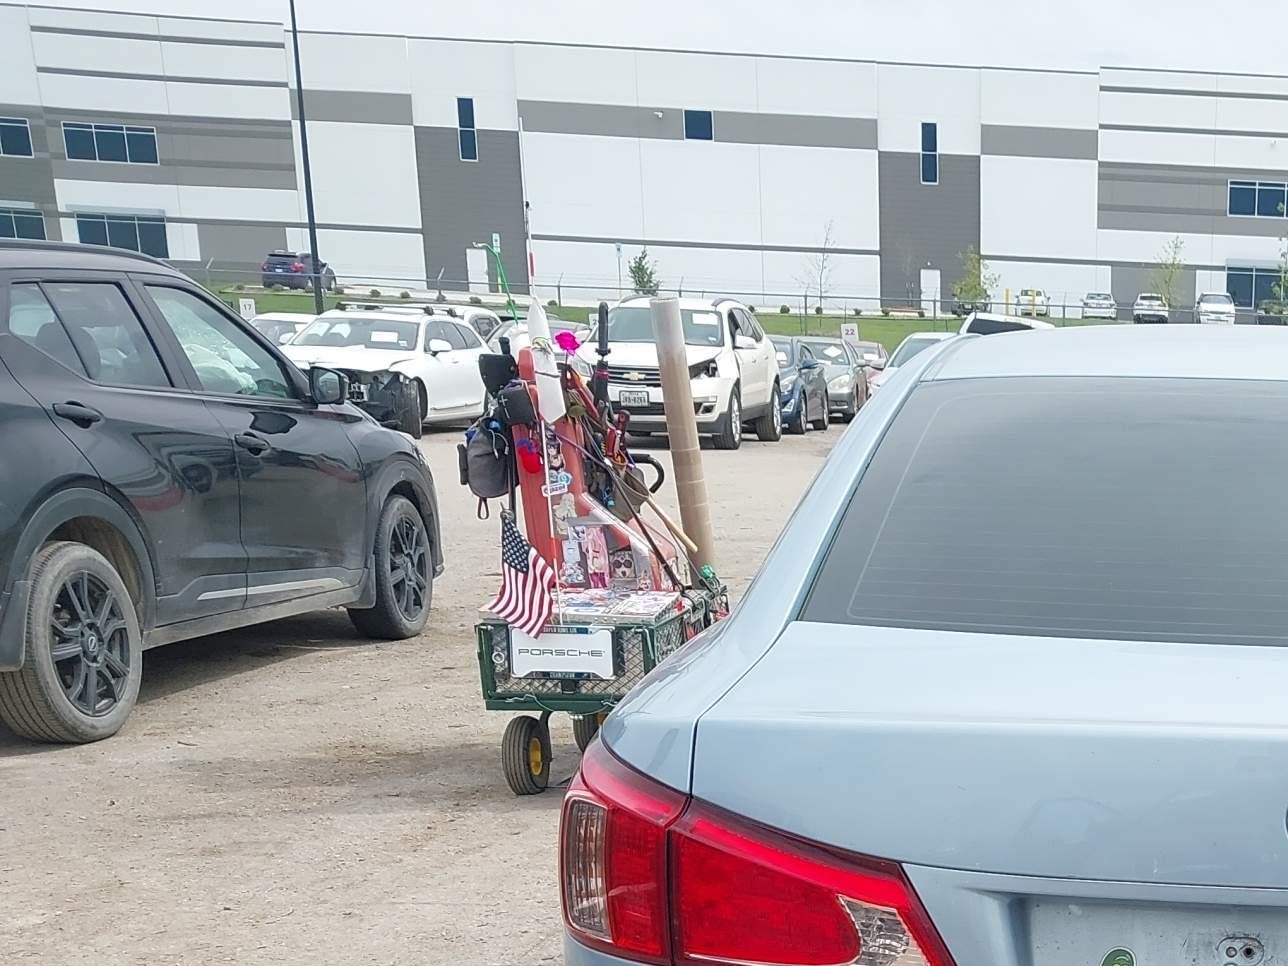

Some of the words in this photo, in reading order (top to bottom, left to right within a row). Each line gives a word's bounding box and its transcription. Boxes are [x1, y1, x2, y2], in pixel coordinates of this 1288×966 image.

[243, 303, 252, 311] 17
[844, 328, 856, 336] 22
[518, 648, 604, 657] PORSCHE
